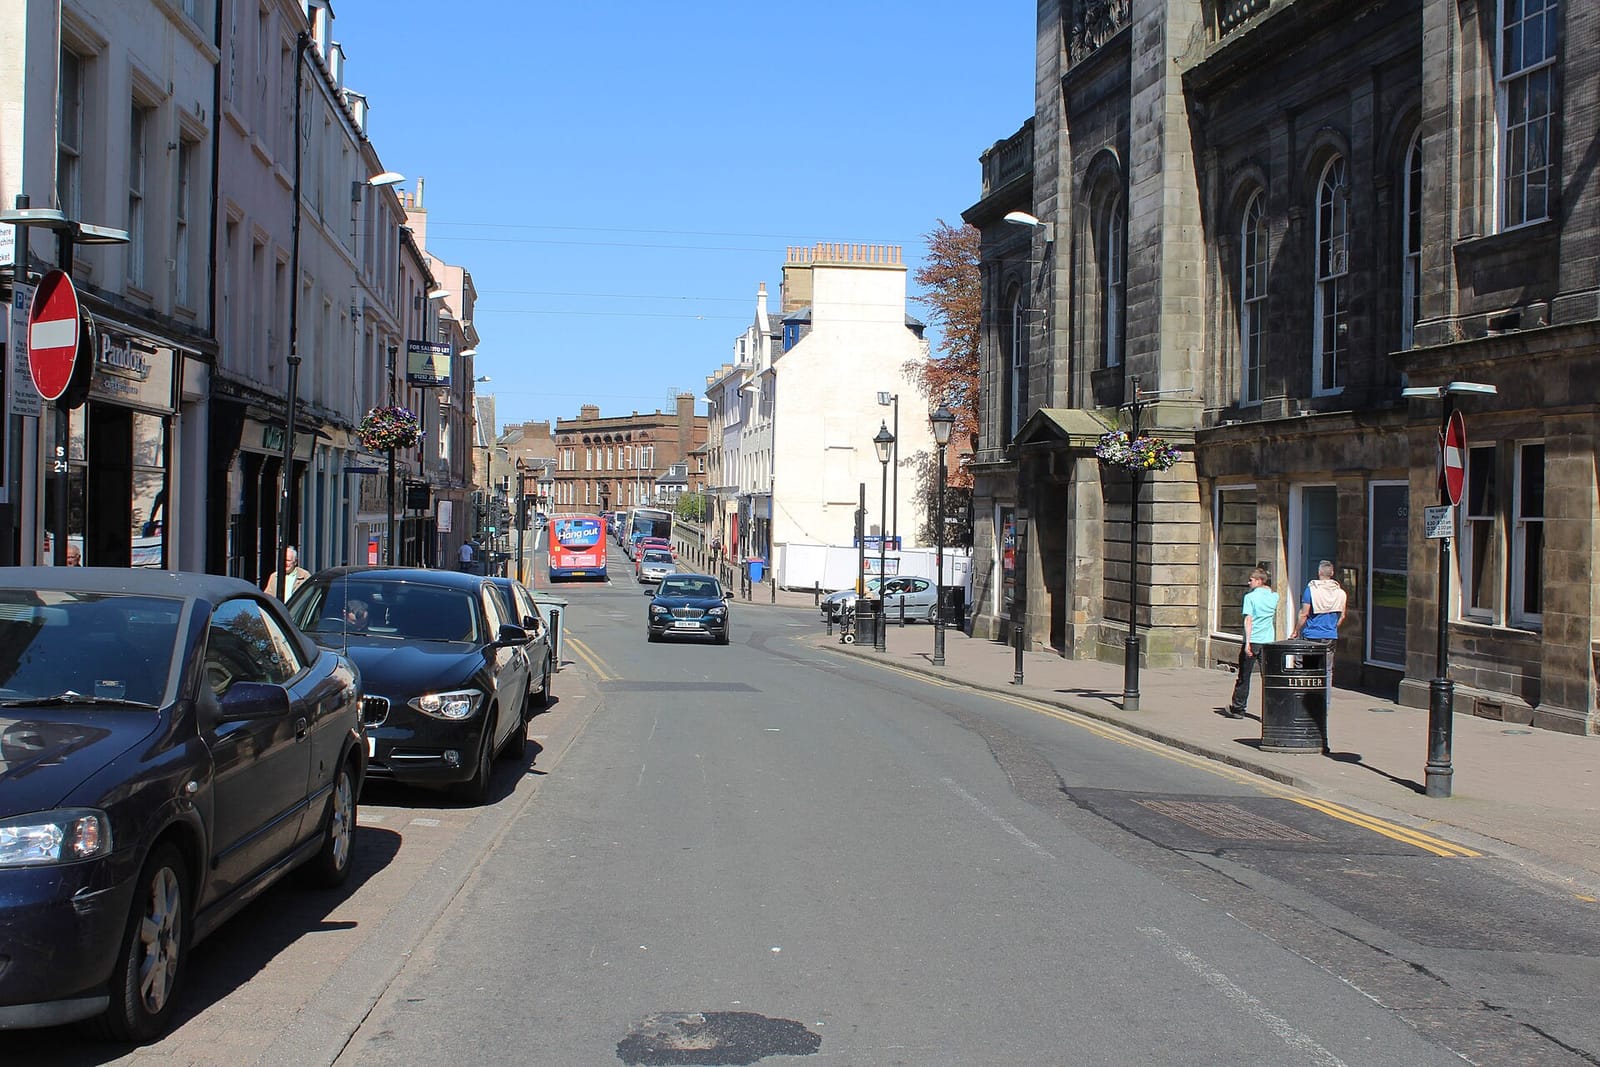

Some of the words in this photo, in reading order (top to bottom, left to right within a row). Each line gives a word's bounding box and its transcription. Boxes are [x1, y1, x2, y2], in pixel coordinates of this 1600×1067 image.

[56, 446, 65, 457] S
[557, 529, 582, 541] Hang
[583, 527, 598, 536] out
[1288, 678, 1322, 687] LITTER
